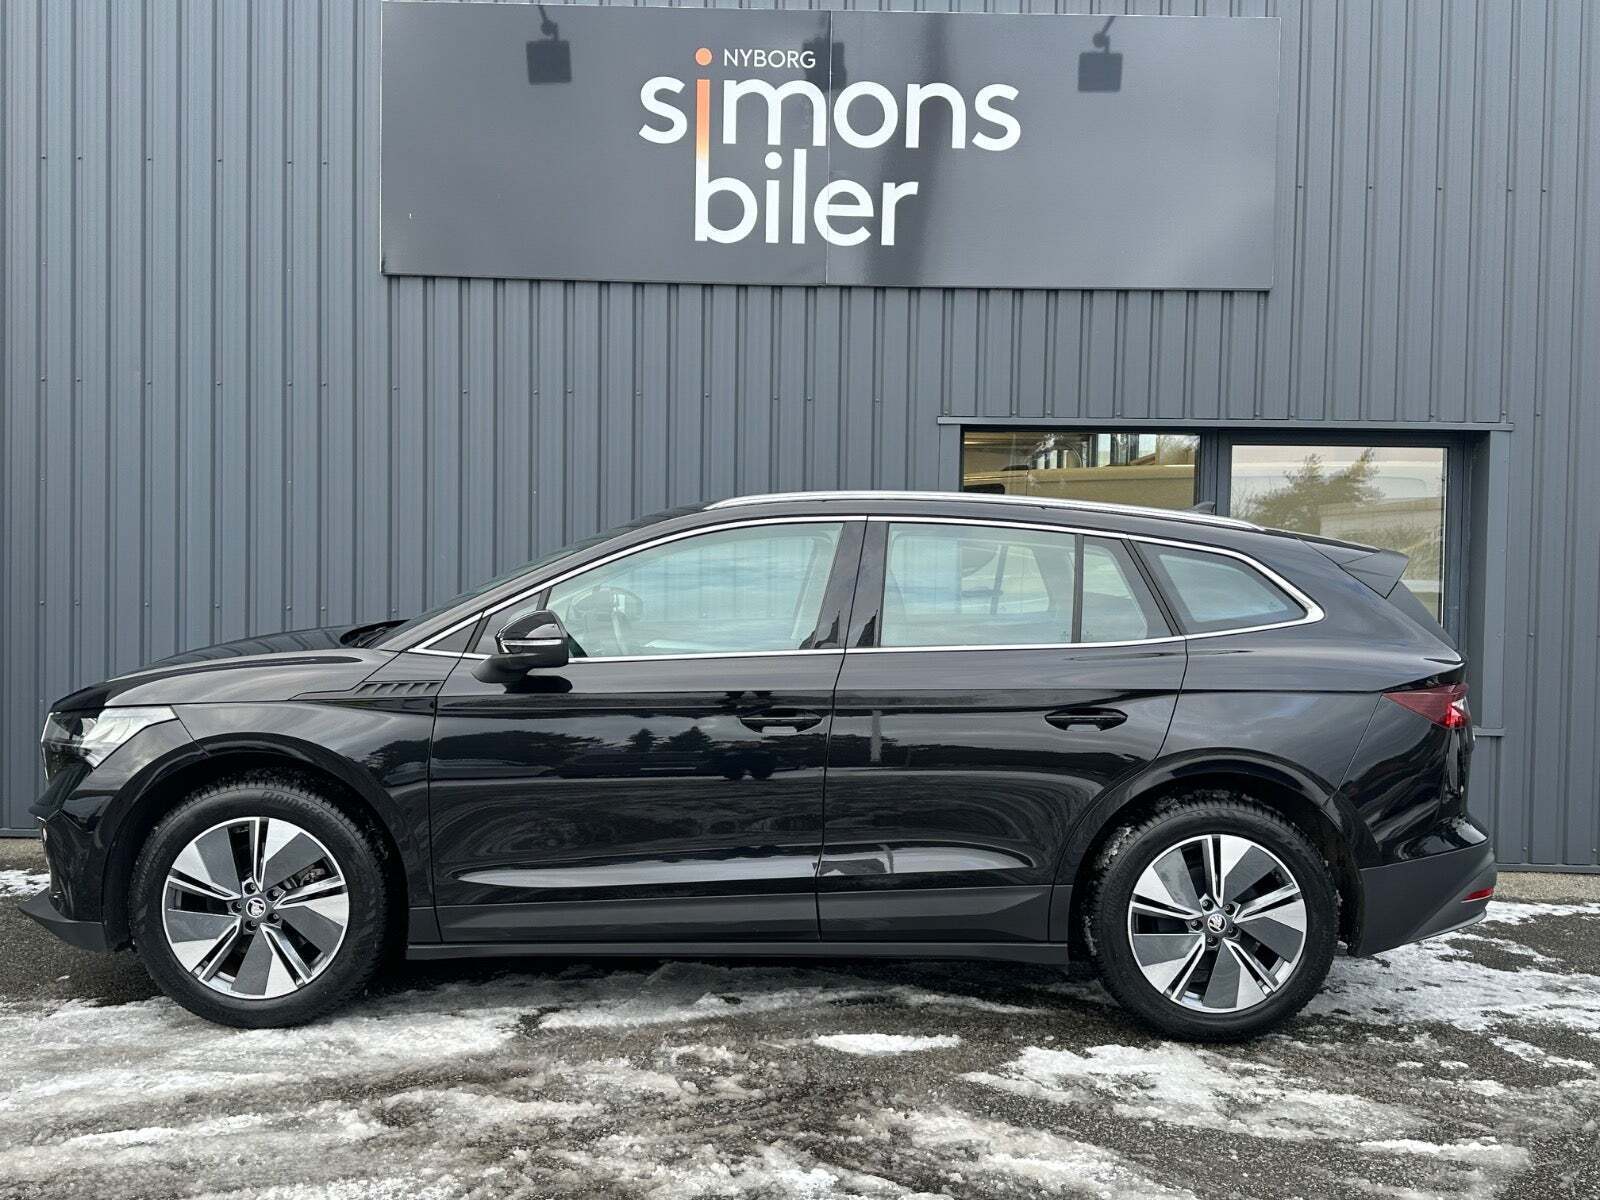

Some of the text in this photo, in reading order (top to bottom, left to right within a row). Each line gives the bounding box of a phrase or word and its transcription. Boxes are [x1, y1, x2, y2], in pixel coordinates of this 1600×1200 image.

[638, 47, 1022, 152] simons
[723, 48, 816, 69] NYBORG
[694, 147, 919, 247] biler
